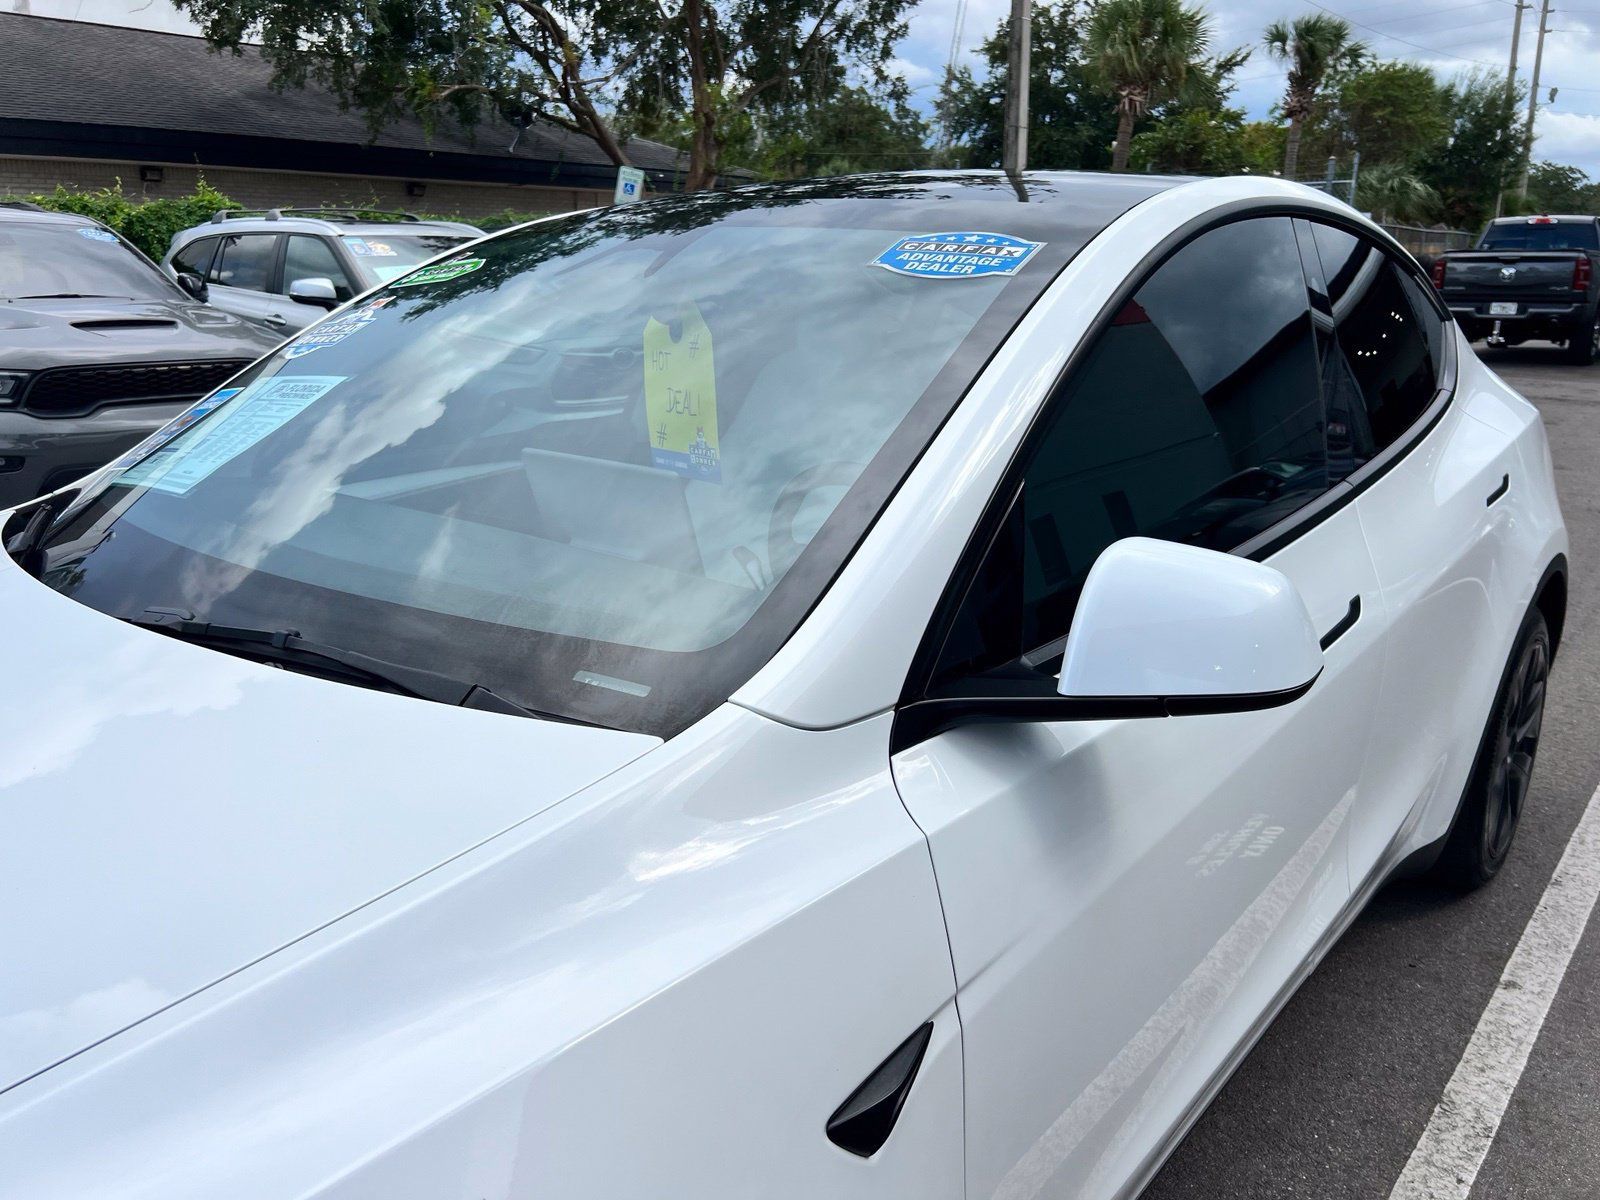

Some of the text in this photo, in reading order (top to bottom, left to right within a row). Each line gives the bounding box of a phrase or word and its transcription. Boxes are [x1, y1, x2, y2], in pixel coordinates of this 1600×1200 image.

[899, 241, 1025, 258] CARFAX
[896, 252, 1006, 267] ADVANTAGE
[903, 261, 977, 275] DEALER
[651, 350, 672, 372] HOT
